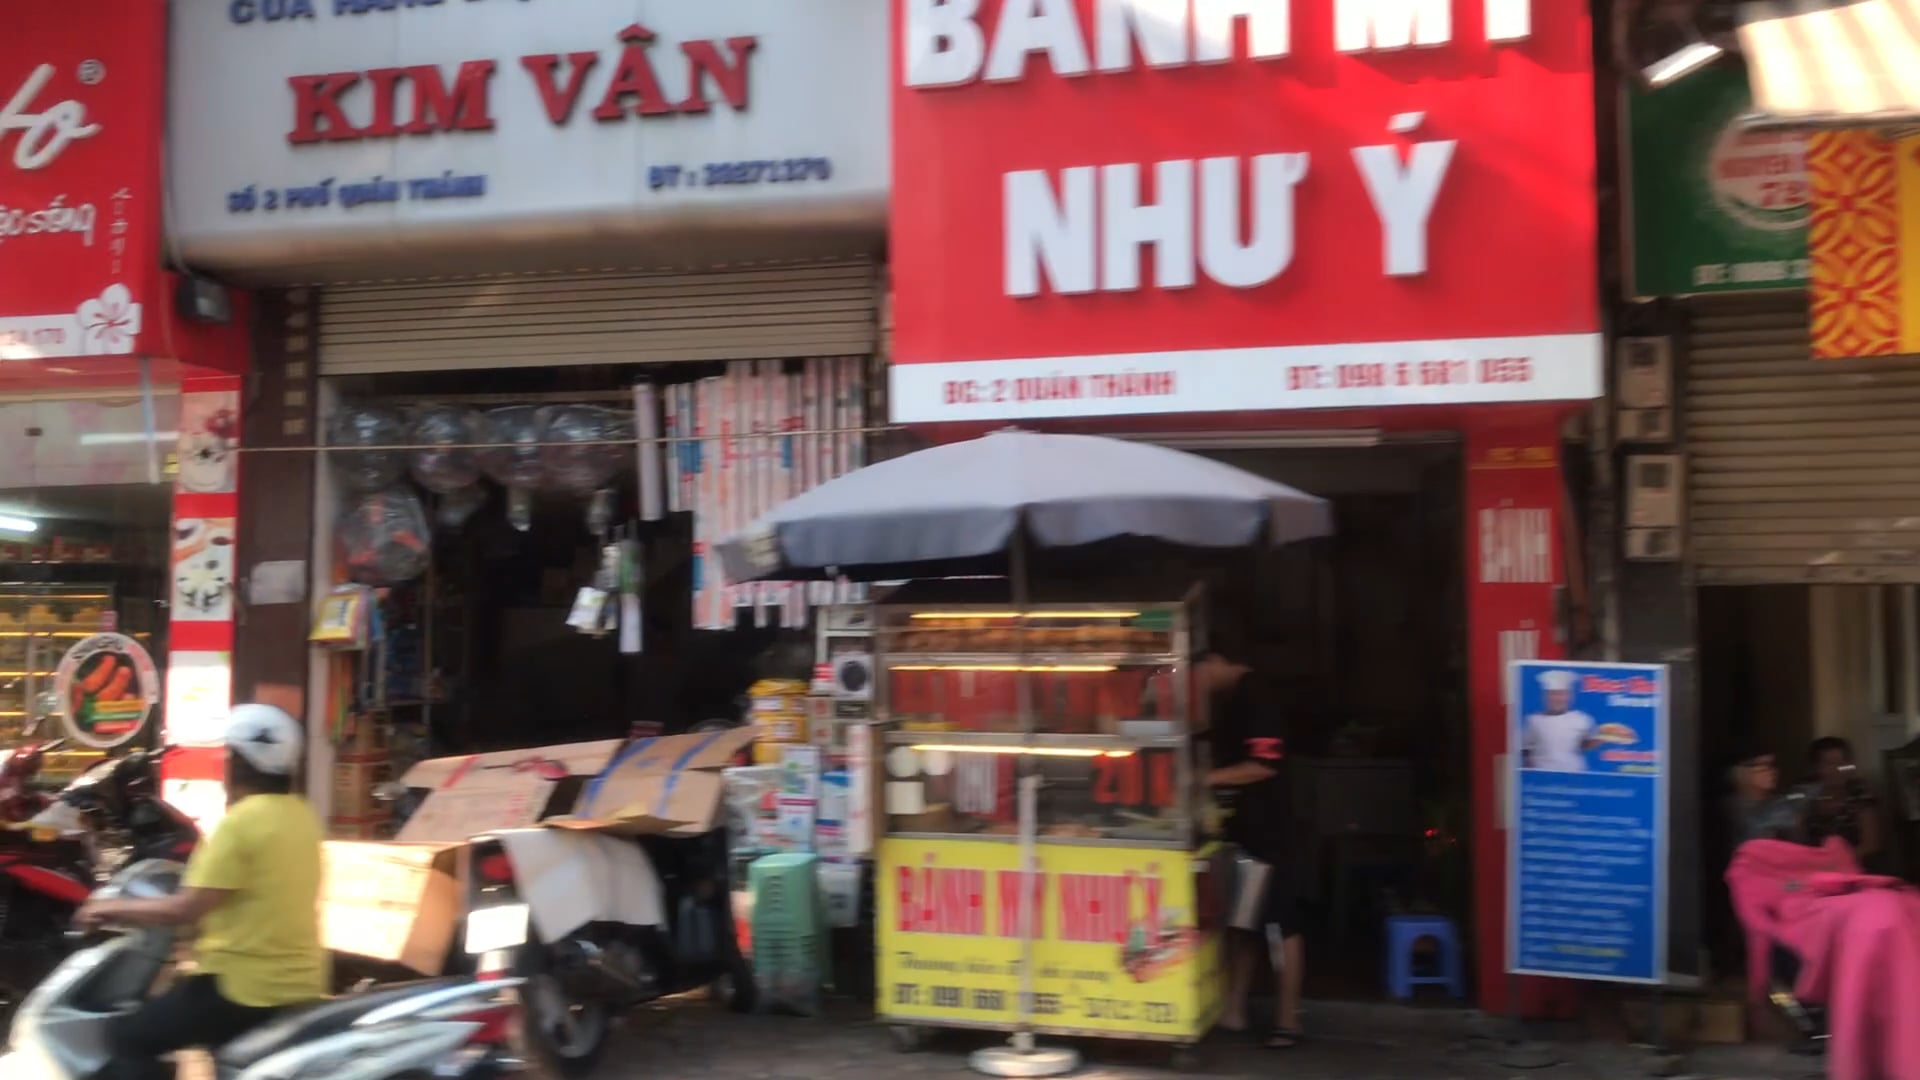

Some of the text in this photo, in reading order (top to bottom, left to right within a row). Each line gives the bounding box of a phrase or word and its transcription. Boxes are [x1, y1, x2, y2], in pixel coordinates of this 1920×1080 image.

[287, 23, 760, 145] KIM VÂN
[1003, 111, 1458, 299] NHƯ Ý
